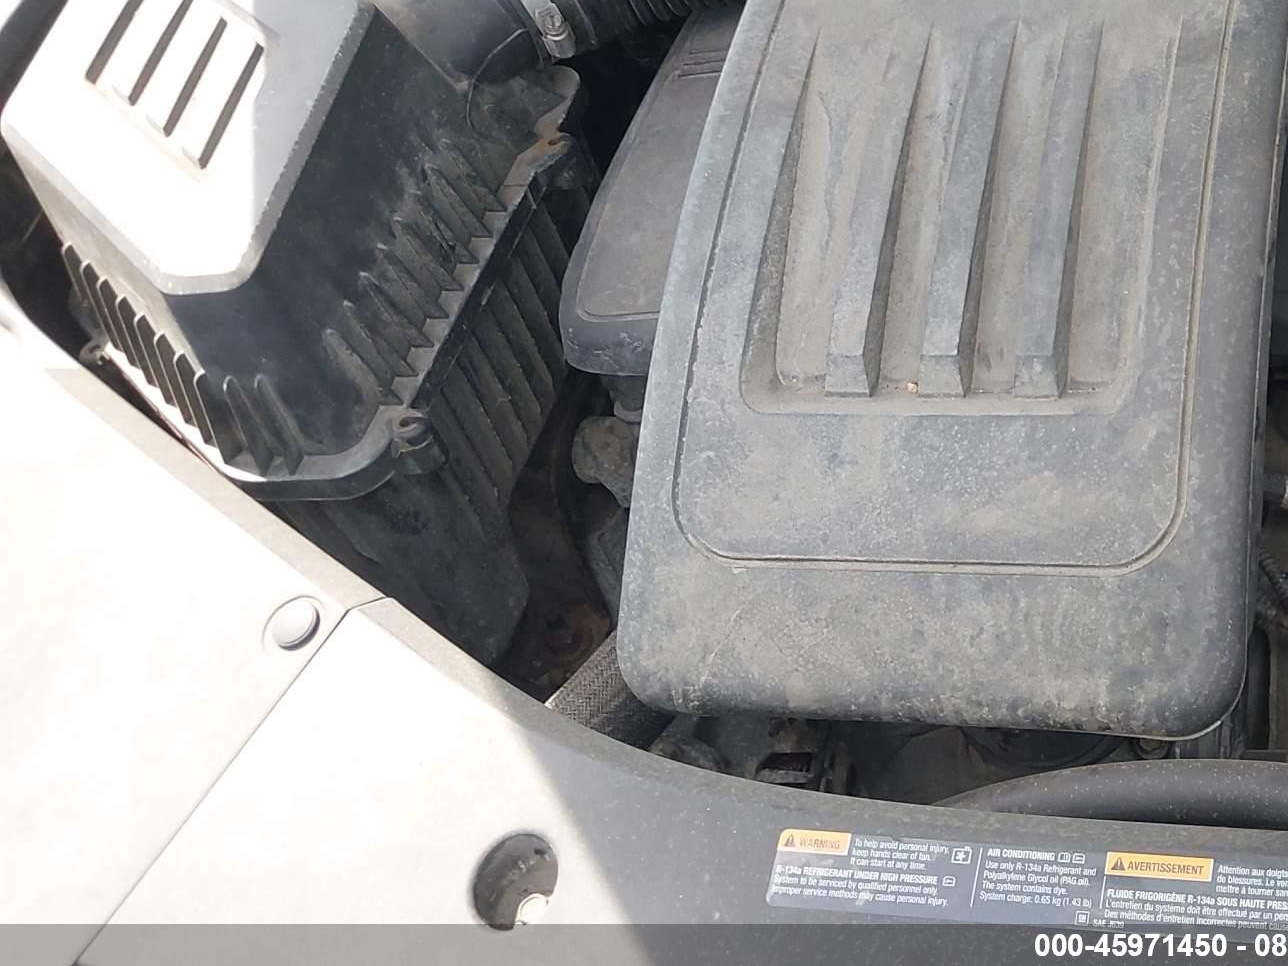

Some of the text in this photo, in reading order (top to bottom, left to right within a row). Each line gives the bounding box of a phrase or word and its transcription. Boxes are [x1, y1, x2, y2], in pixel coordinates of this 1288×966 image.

[800, 838, 840, 850] WARNING
[855, 838, 862, 846] To
[864, 839, 878, 849] help
[880, 840, 898, 848] avoid
[899, 842, 928, 852] personal
[852, 848, 868, 857] keep
[870, 849, 891, 858] hands
[892, 850, 908, 859] clear
[910, 852, 918, 860] of
[987, 848, 1056, 860] AIR CONDITIONING
[850, 856, 856, 864] It
[856, 858, 869, 866] can
[870, 859, 886, 867] start
[887, 860, 894, 868] at
[895, 861, 908, 870] any
[985, 859, 1096, 876] Use only R-134a Refrigerant and
[1127, 860, 1205, 874] AVERTISSEMENT
[1218, 865, 1250, 875] Attention
[776, 864, 938, 884] R-134a REFRIGERANT UNDER HIGH PRESSURE
[984, 870, 1026, 881] Polyalkylene
[1027, 874, 1048, 883] Glycol
[1050, 875, 1059, 884] oil
[1060, 876, 1076, 886] (PAG
[1216, 875, 1226, 883] de
[1228, 875, 1264, 886] blessures.
[1266, 878, 1275, 886] Le
[774, 874, 799, 885] System
[800, 876, 807, 884] to
[808, 877, 817, 885] be
[818, 878, 847, 888] serviced
[848, 880, 857, 890] by
[858, 881, 887, 892] qualified
[888, 884, 922, 893] personnel
[982, 880, 1068, 895] The system contains dye.
[1216, 885, 1239, 893] mettre
[1241, 886, 1246, 894] à
[1247, 887, 1274, 896] tourner
[803, 888, 828, 896] service
[829, 889, 857, 898] methods
[875, 893, 896, 901] cause
[897, 894, 927, 904] personal
[980, 891, 1005, 901] System
[1007, 893, 1032, 904] charge:
[1034, 894, 1050, 904] 0.65
[1052, 896, 1061, 906] kg
[1083, 898, 1092, 908] lb)
[1107, 888, 1134, 899] FLUIDE
[1187, 895, 1215, 905] R-134a
[1216, 896, 1238, 906] SOUS
[1240, 898, 1266, 908] HAUTE
[1144, 901, 1153, 910] du
[1187, 905, 1201, 914] doit
[1249, 911, 1262, 919] par
[1093, 919, 1106, 927] SAE
[1104, 909, 1118, 918] Des
[1196, 917, 1237, 927] incorrectes
[1238, 920, 1267, 930] peuvent
